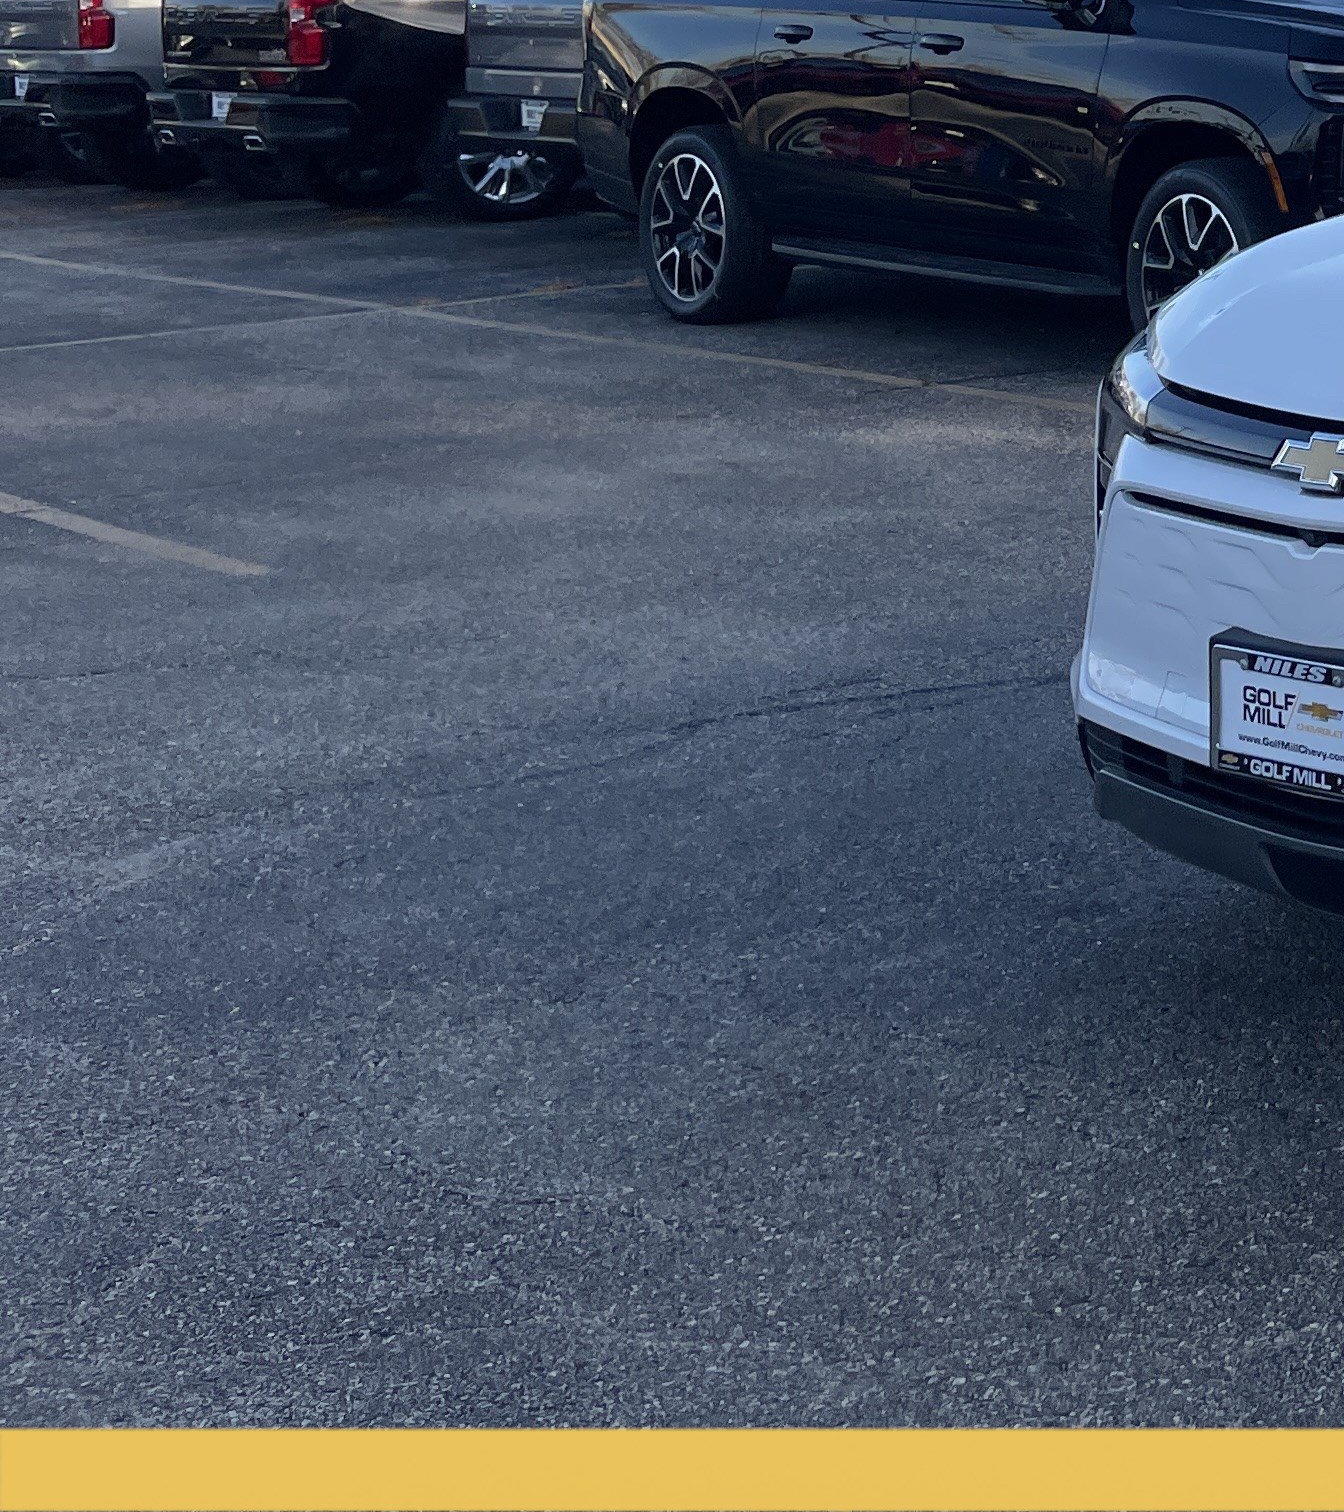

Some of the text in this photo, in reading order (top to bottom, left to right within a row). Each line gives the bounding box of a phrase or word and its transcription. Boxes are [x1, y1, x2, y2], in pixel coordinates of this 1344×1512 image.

[1253, 656, 1327, 683] NILES
[1243, 685, 1297, 711] GOLF
[1243, 703, 1286, 729] MILL
[1249, 758, 1332, 790] GOLF MILL
